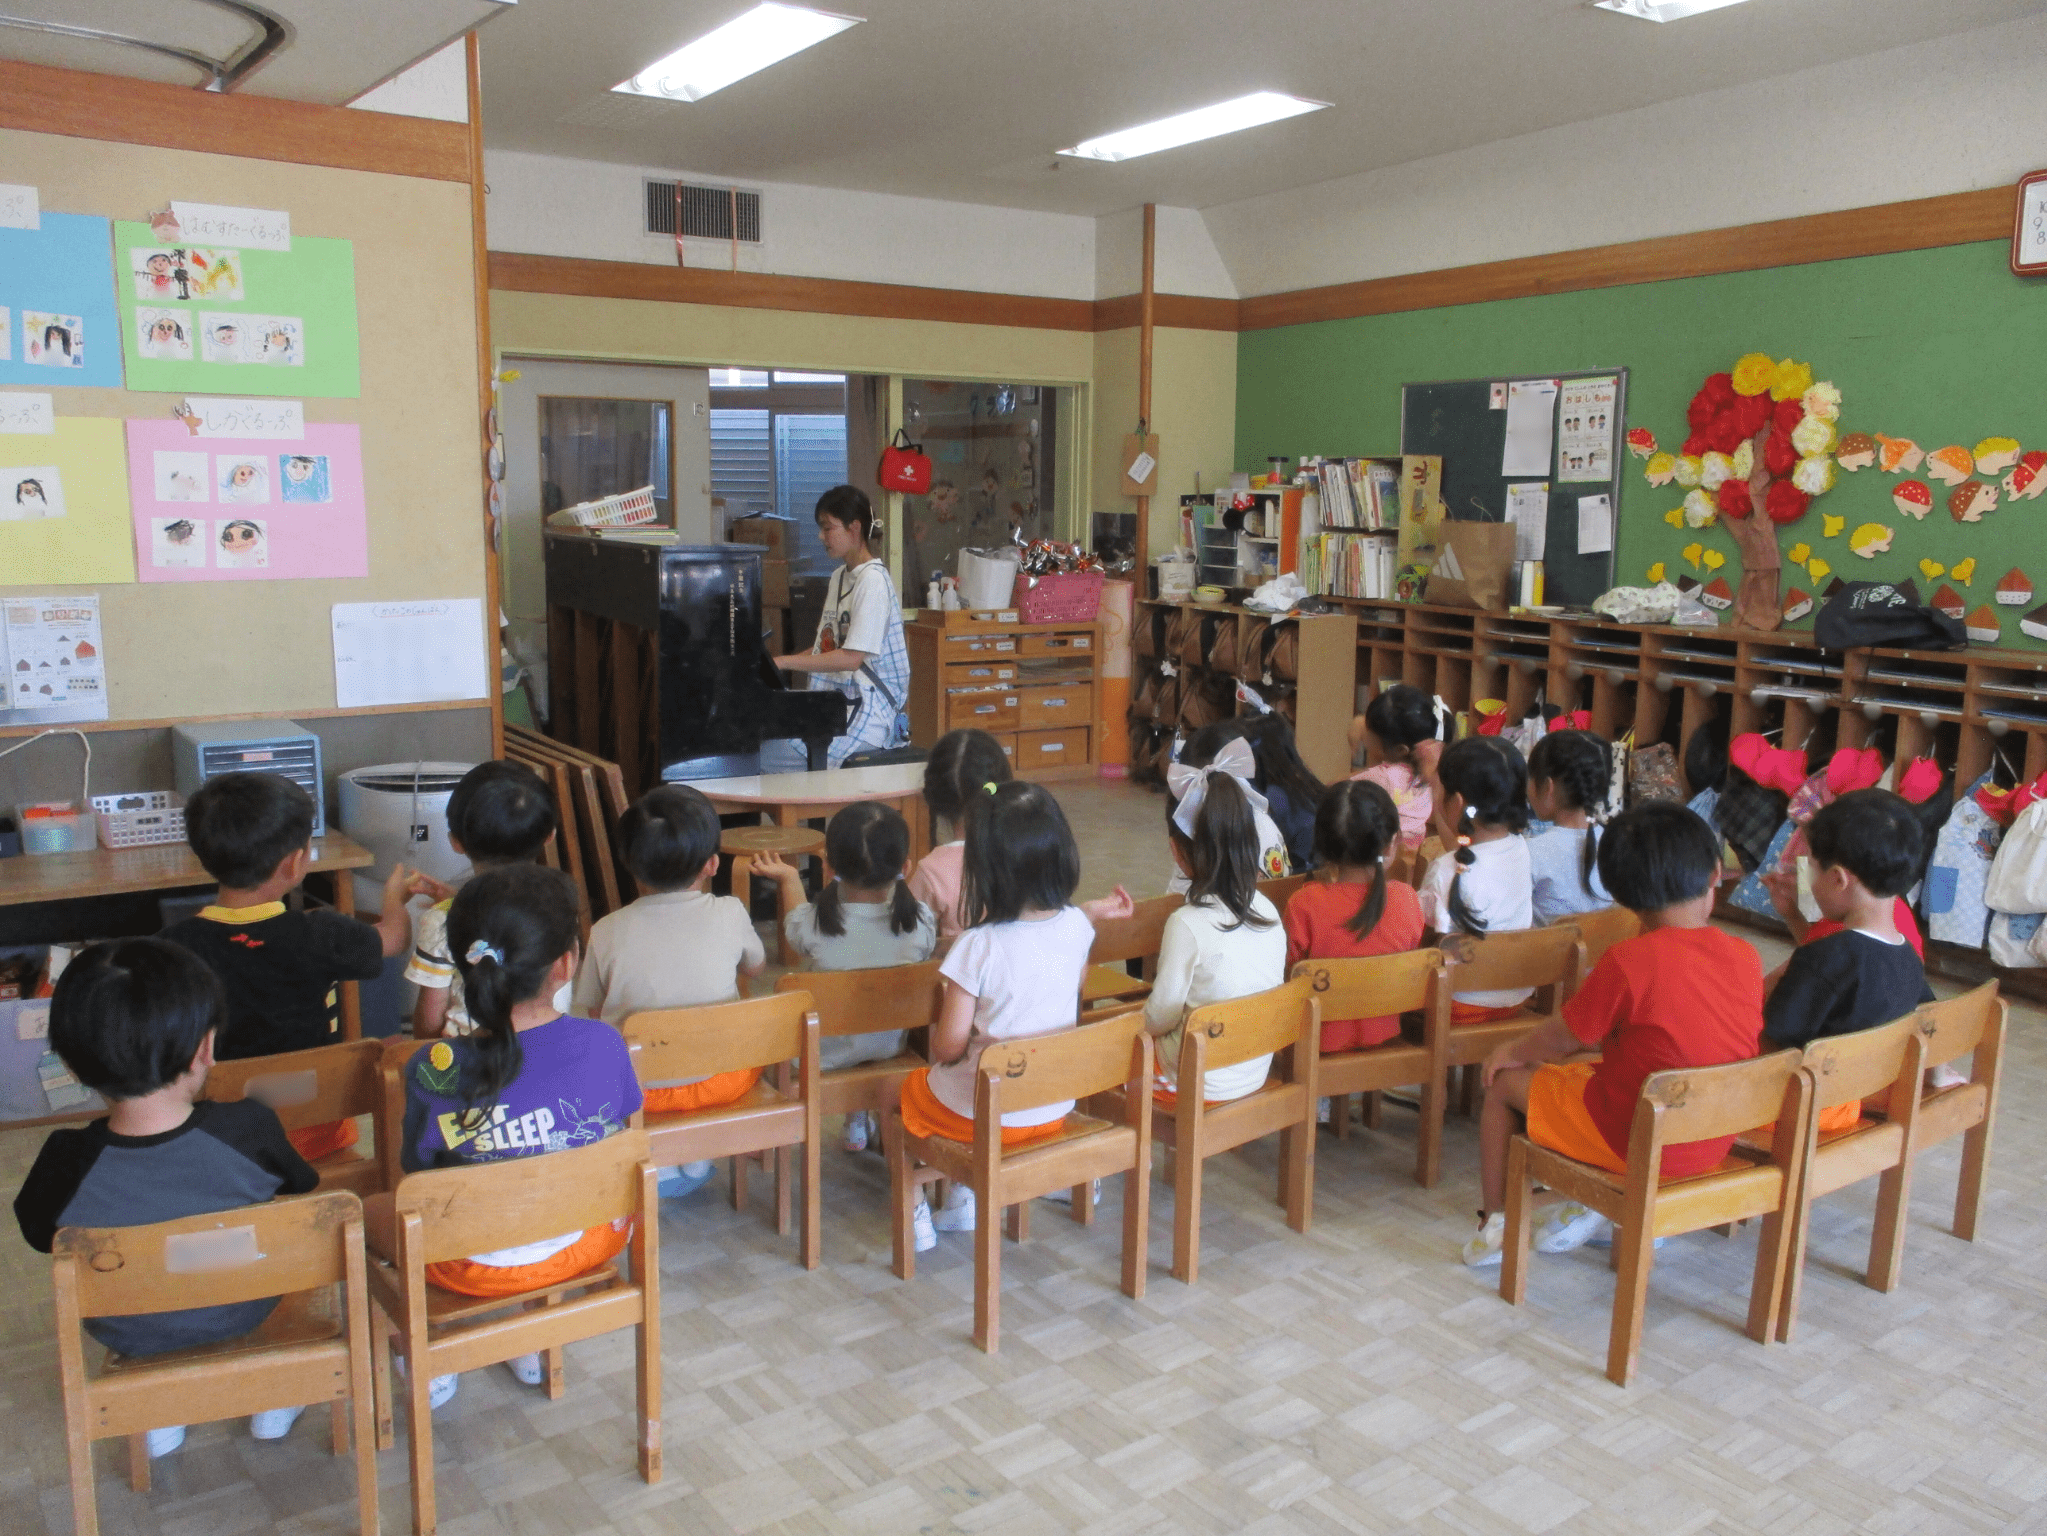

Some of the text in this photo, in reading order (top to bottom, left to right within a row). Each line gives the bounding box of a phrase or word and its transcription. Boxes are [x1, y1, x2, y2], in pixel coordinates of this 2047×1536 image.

[2033, 216, 2043, 230] 9
[2037, 231, 2046, 245] 8
[1312, 968, 1330, 992] 3
[1005, 1050, 1028, 1079] 9
[474, 1107, 555, 1152] SLEEP
